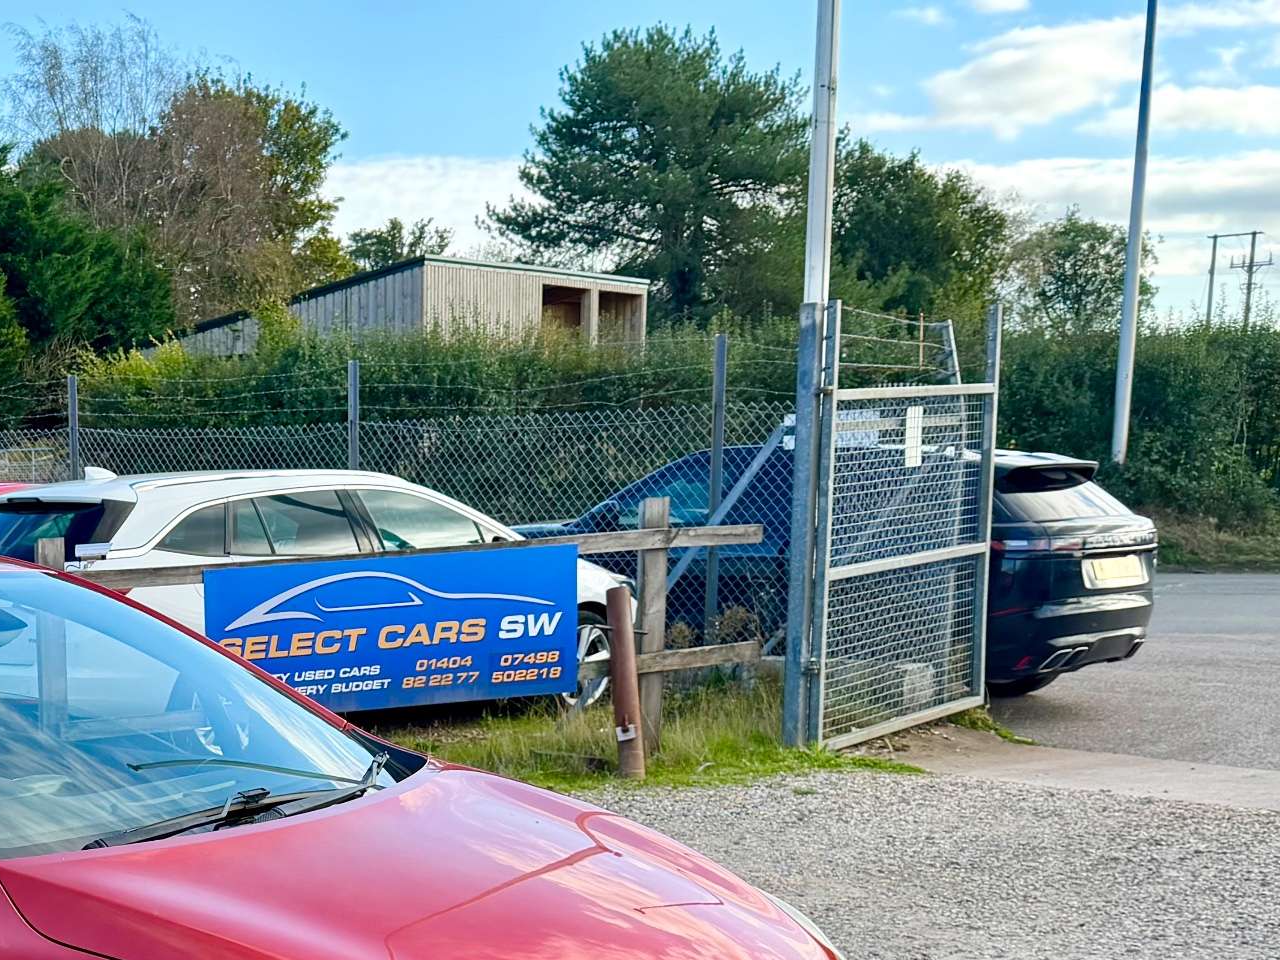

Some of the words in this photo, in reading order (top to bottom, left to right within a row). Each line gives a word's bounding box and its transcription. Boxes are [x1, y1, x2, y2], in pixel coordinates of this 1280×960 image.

[219, 628, 368, 661] SELECT
[377, 618, 487, 649] CARS
[498, 611, 563, 640] SW
[415, 655, 473, 671] 01404
[499, 650, 560, 667] 07498
[293, 669, 336, 682] USED
[339, 665, 381, 678] CARS
[491, 666, 562, 683] 502218
[331, 678, 391, 693] BUDGET
